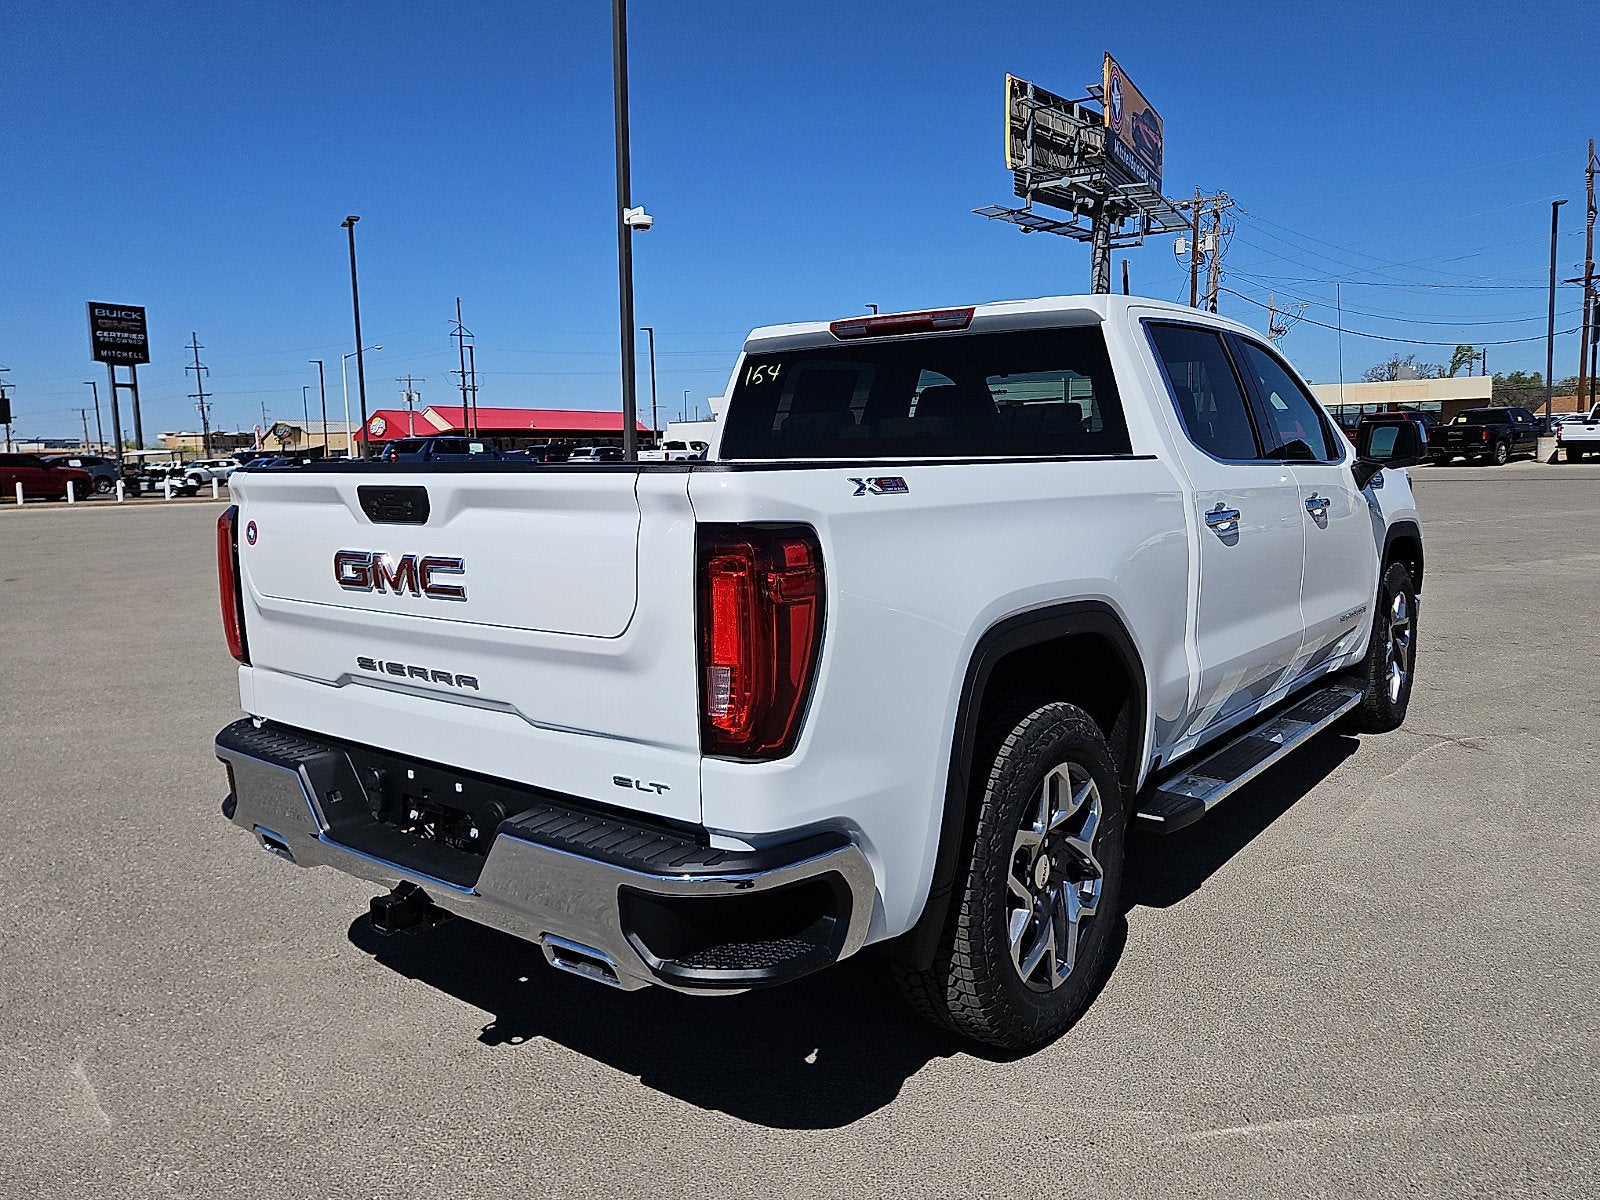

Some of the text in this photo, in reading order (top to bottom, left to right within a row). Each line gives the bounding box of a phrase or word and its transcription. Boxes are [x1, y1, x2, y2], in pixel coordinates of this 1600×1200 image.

[95, 308, 142, 320] BUICK
[96, 330, 145, 340] CERTIFIED
[100, 350, 144, 359] MITCHELL
[334, 550, 468, 602] GMC
[356, 656, 480, 690] SIERRA
[613, 775, 671, 795] SLT
